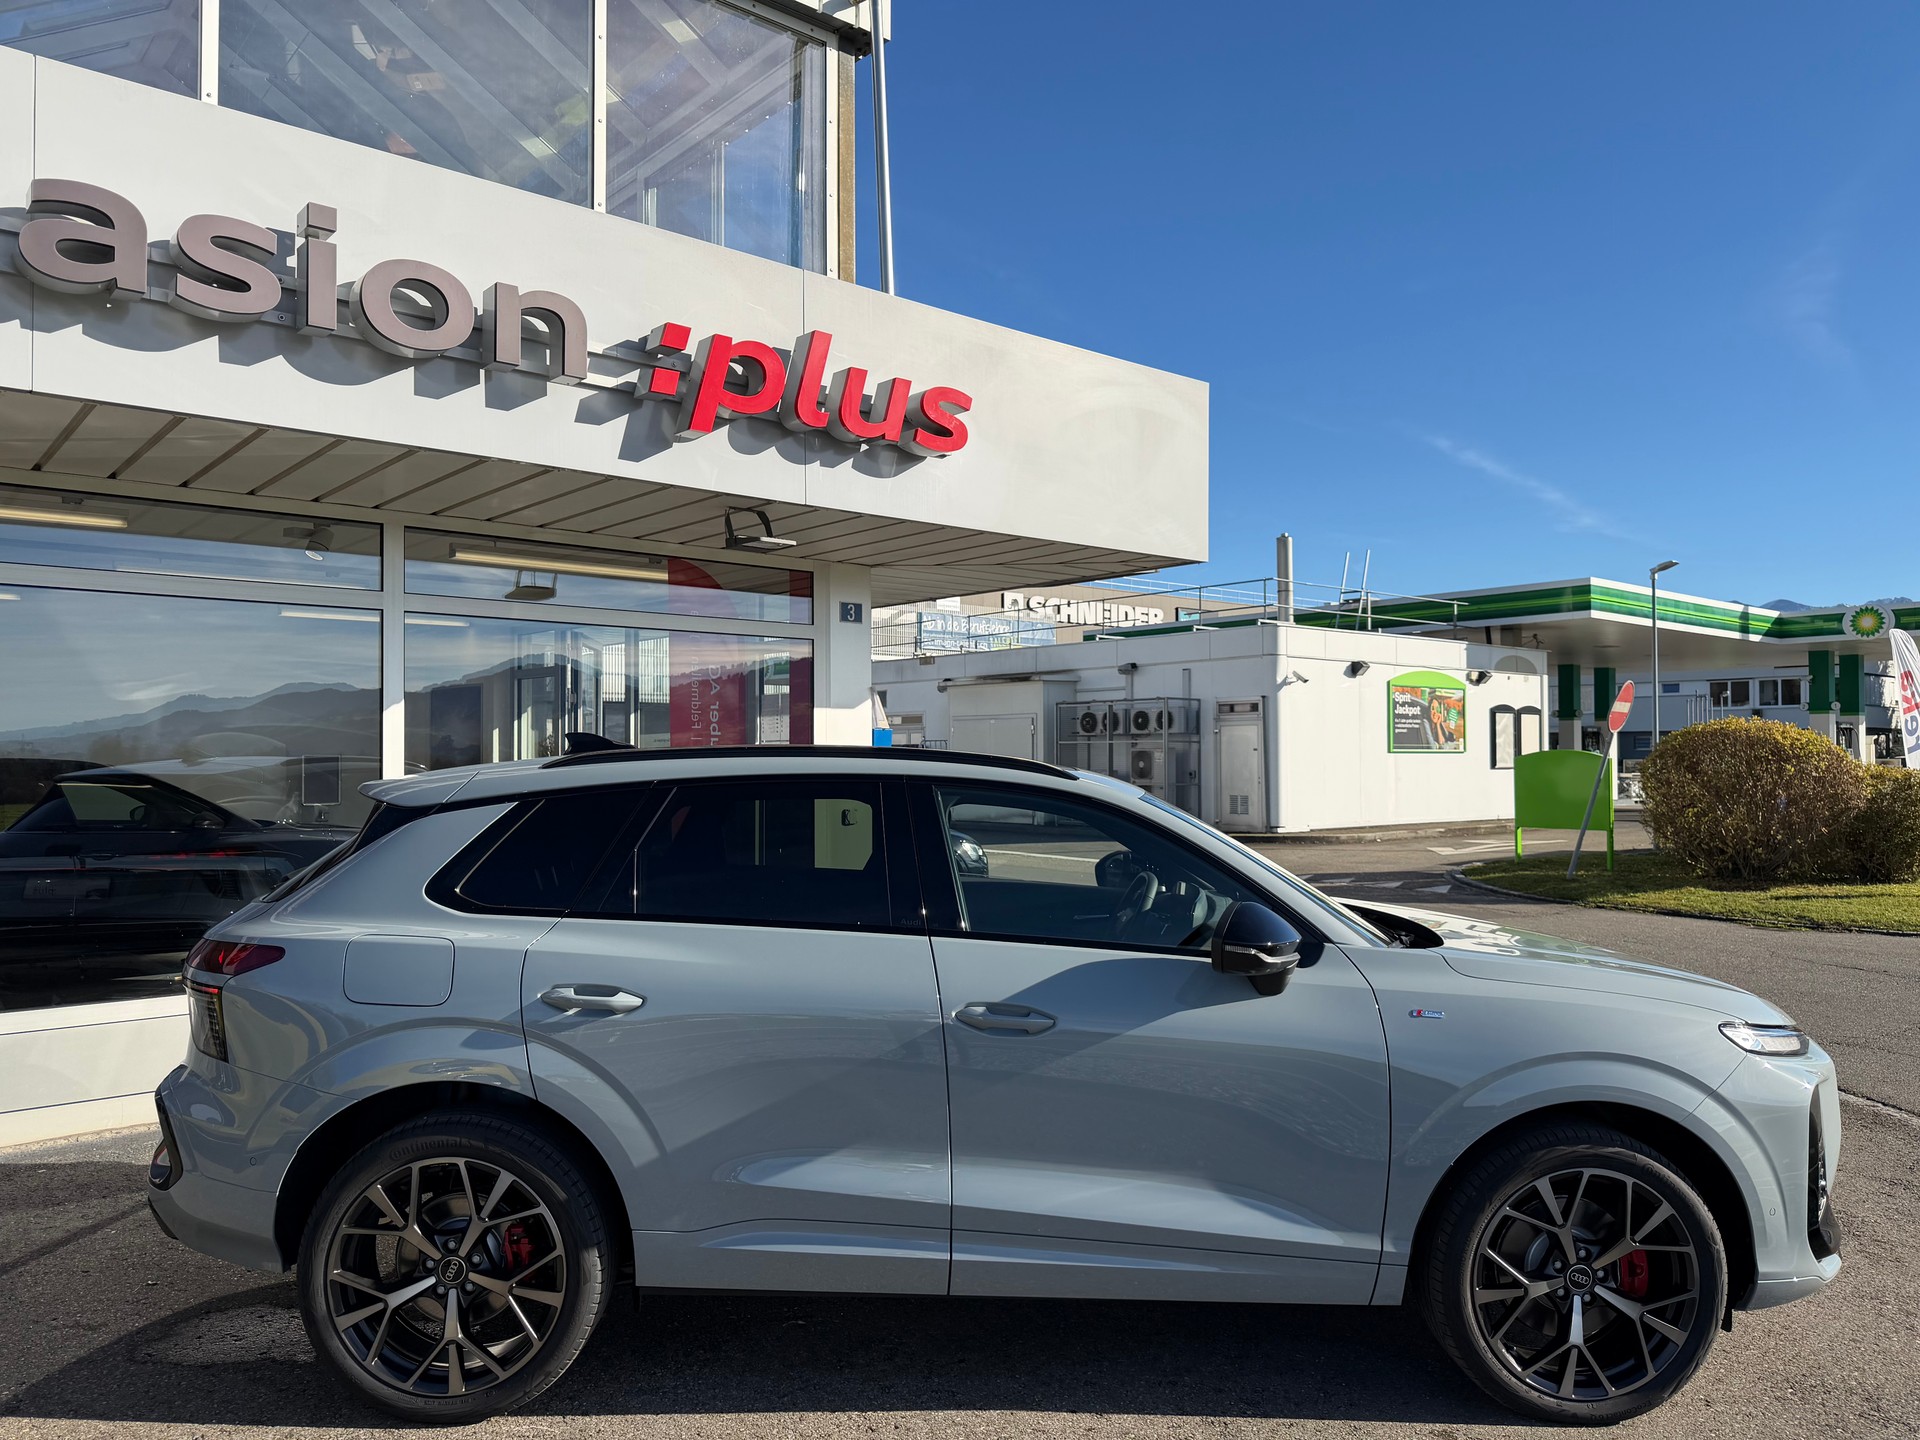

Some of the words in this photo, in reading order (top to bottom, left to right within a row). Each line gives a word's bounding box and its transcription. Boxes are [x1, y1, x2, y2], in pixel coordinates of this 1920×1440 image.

[17, 178, 588, 382] asion
[847, 604, 855, 621] 3
[1028, 595, 1164, 626] SCHNEIDER
[1395, 691, 1411, 704] Sprit
[1395, 704, 1421, 716] Jackpot
[900, 918, 921, 926] Audi
[391, 1138, 462, 1159] Continental
